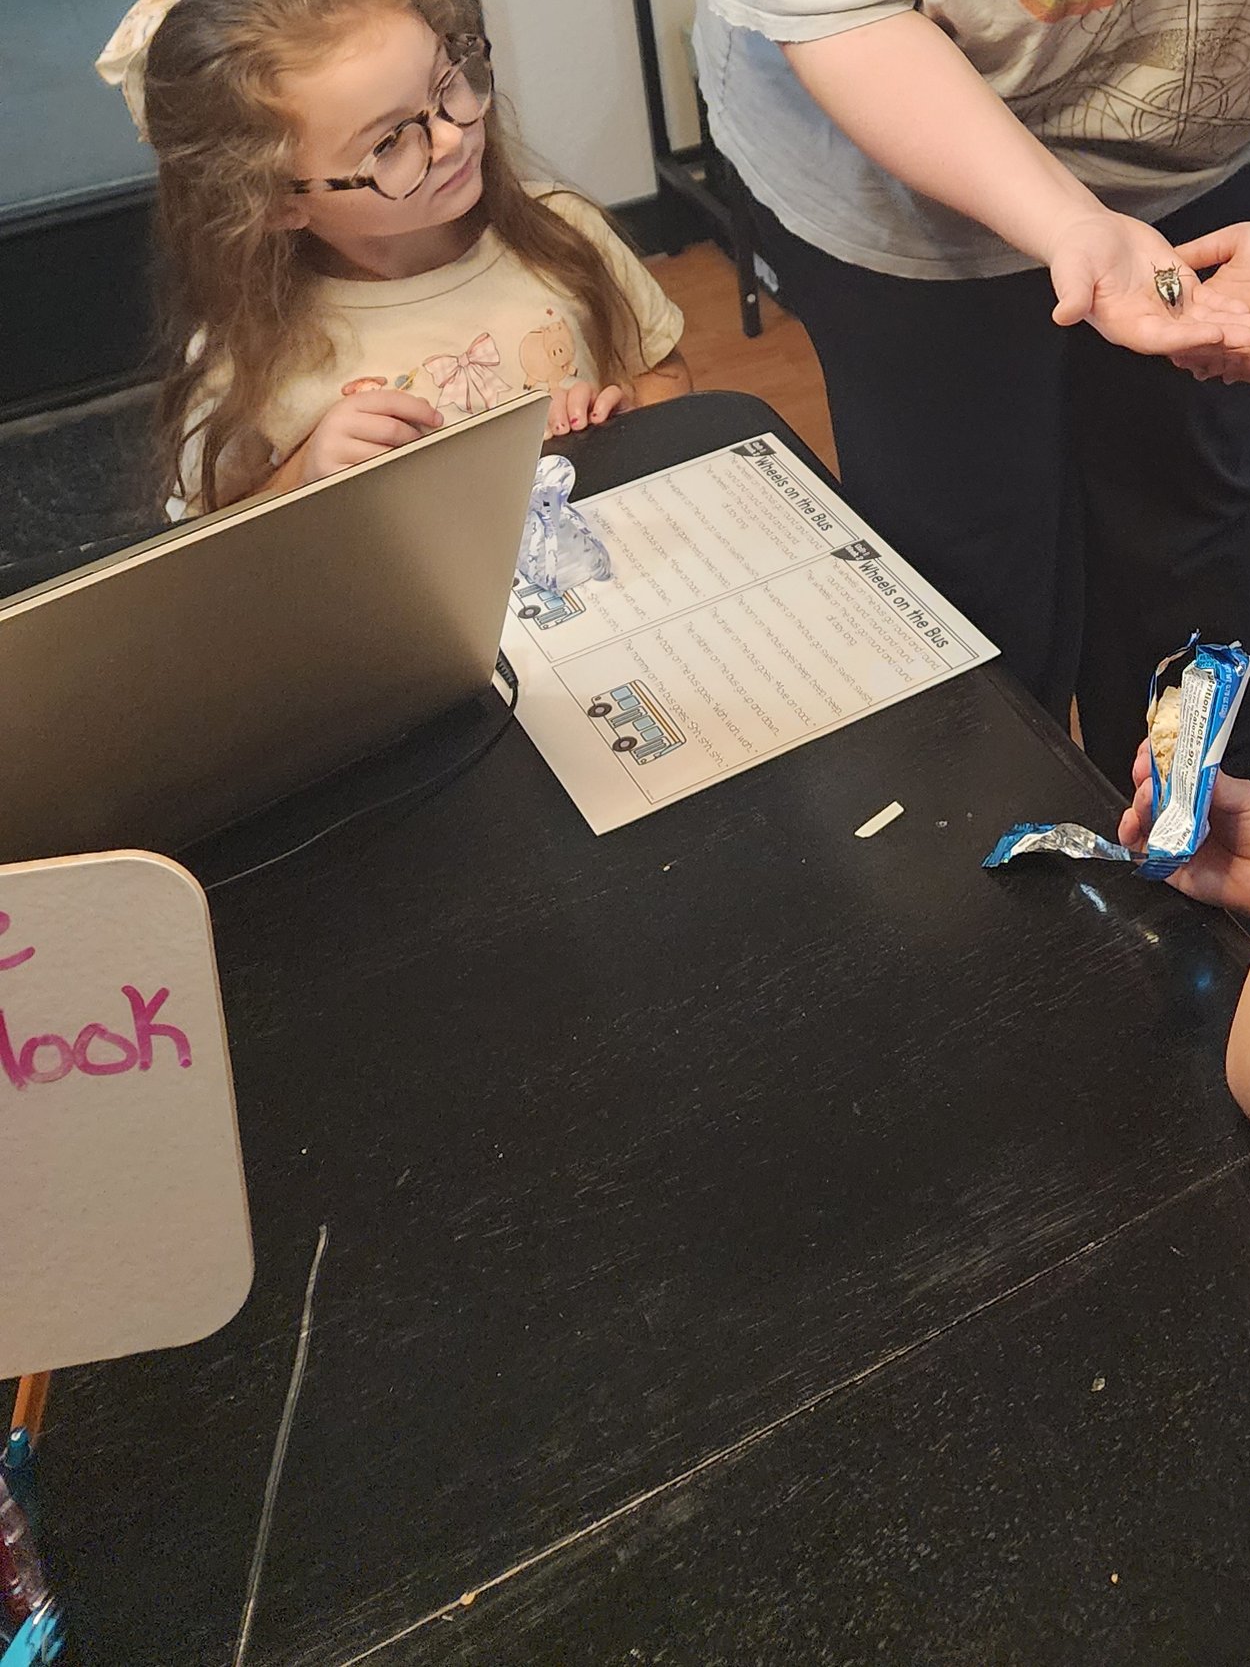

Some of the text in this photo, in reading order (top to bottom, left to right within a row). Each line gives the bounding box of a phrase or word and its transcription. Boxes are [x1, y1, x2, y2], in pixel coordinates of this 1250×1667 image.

[752, 456, 837, 531] Wheels on the Bus
[856, 560, 953, 648] Wheels on the Bus
[1196, 716, 1208, 746] Facts
